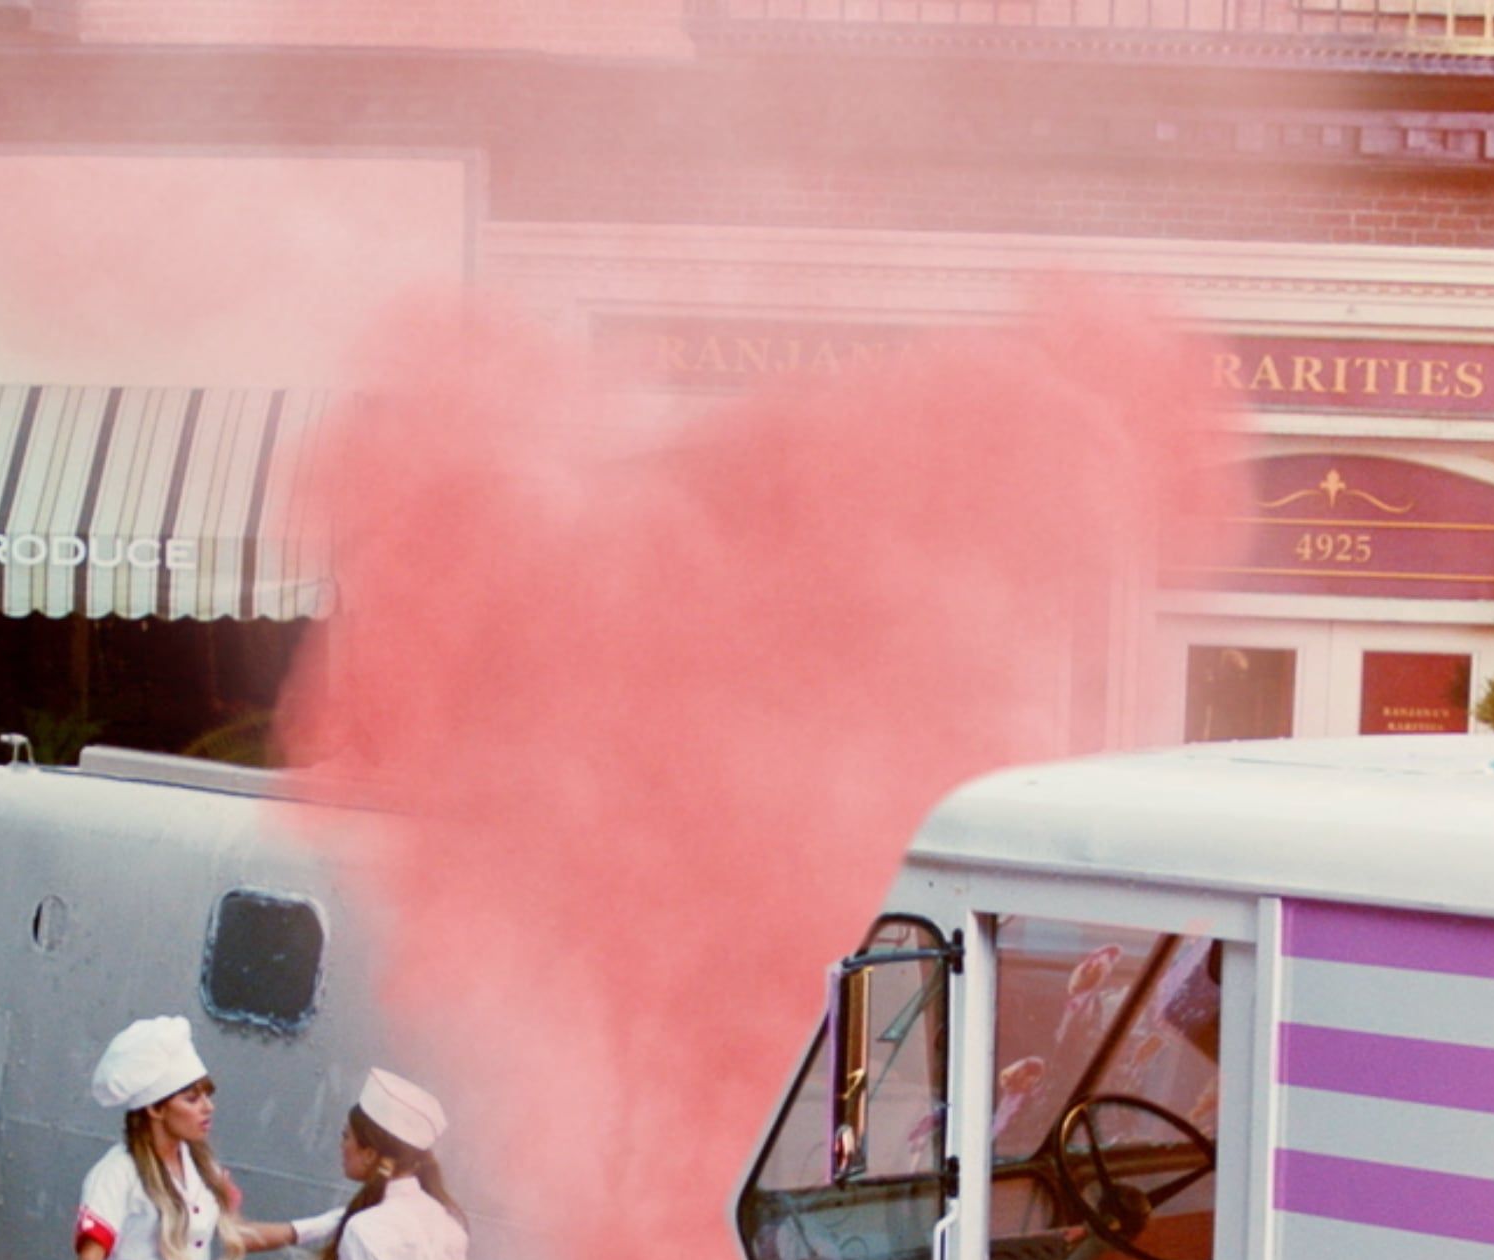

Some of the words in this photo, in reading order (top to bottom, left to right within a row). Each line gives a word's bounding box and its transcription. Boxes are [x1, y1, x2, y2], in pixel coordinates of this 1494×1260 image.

[657, 332, 977, 378] RANJAN
[1211, 351, 1485, 398] RARITIES
[1296, 533, 1372, 563] 4925
